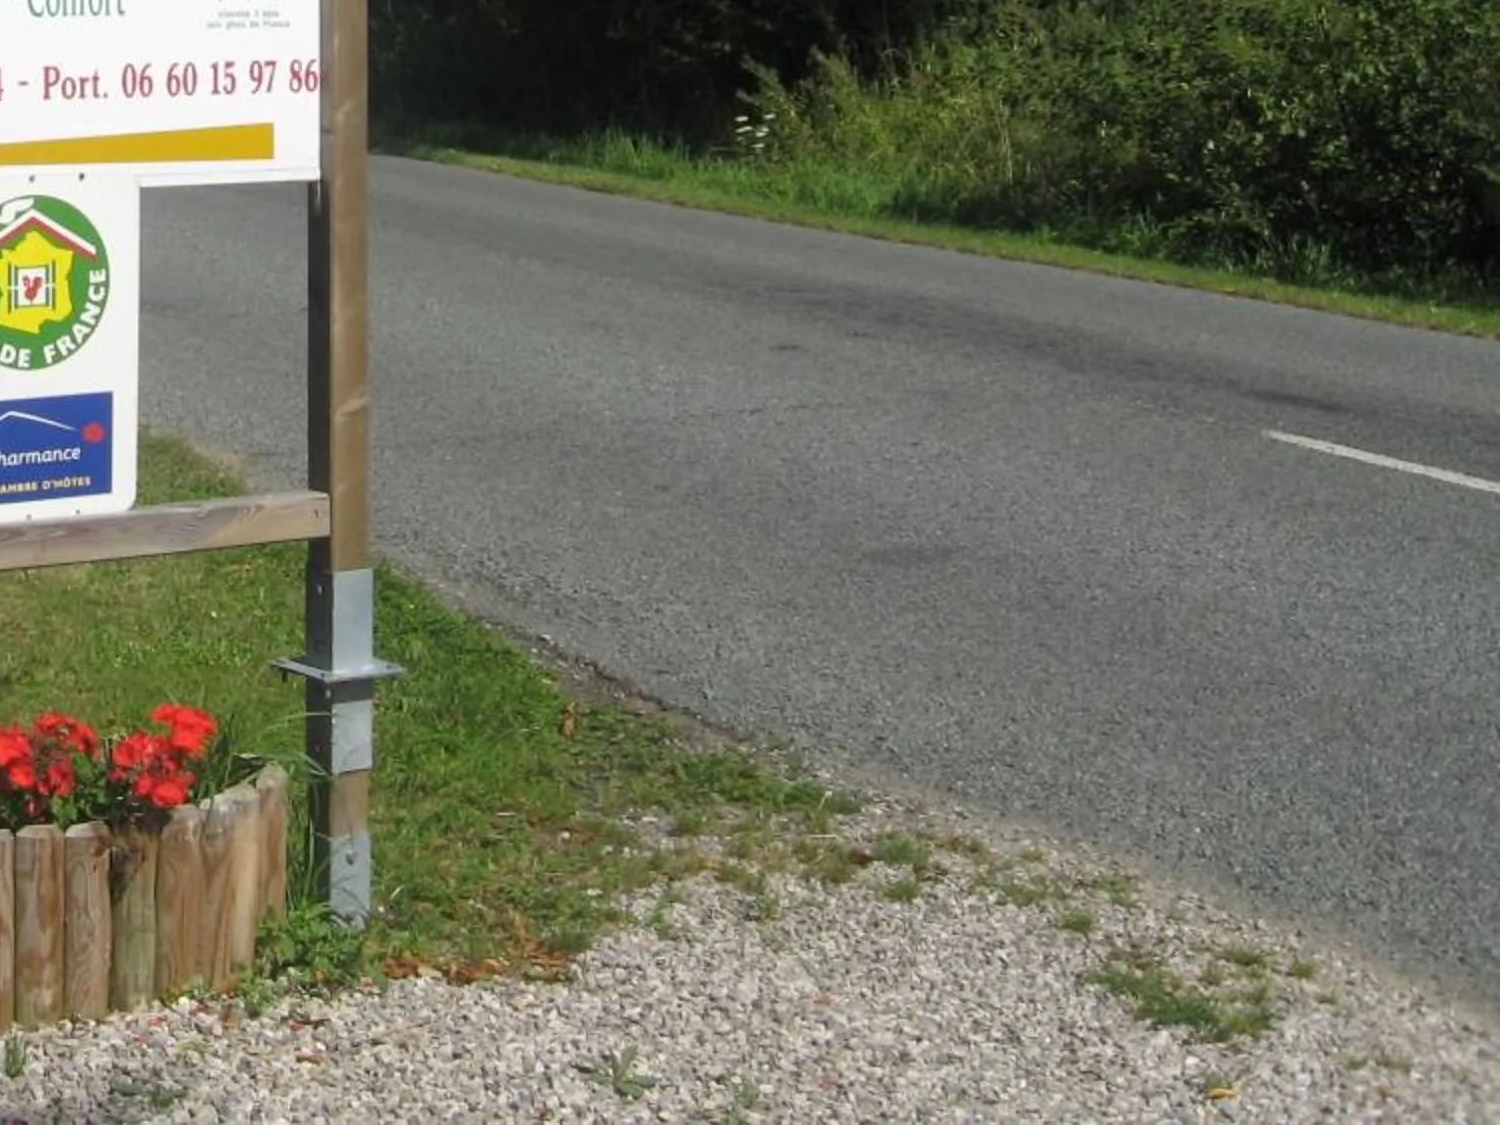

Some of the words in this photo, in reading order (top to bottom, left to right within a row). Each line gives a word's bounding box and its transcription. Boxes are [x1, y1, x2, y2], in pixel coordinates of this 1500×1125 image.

[42, 65, 109, 100] Port.
[121, 63, 154, 99] 06
[166, 62, 198, 97] 60
[210, 61, 238, 95] 15
[249, 60, 278, 94] 97
[288, 59, 319, 93] 86
[42, 268, 107, 365] FRANCE
